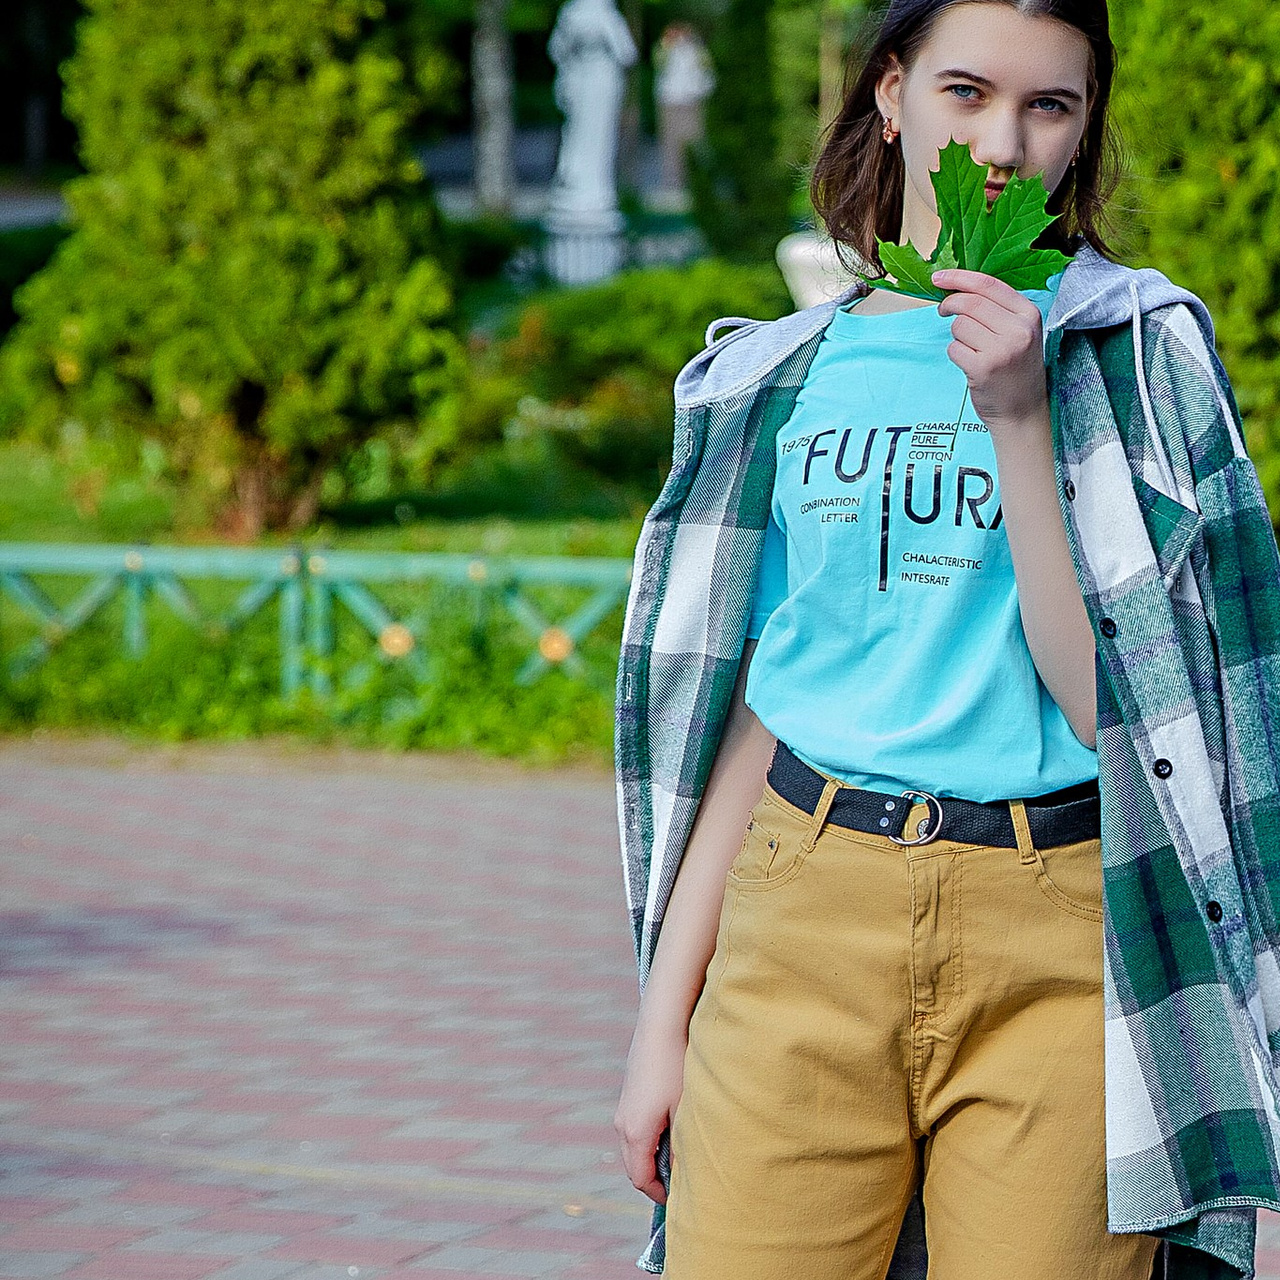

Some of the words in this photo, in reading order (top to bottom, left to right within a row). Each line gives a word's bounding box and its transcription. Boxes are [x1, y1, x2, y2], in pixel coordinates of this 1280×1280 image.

[782, 434, 811, 456] 1975
[911, 435, 938, 444] PURE
[821, 513, 858, 523] LETTER
[902, 552, 983, 570] CHALACTERISTIC
